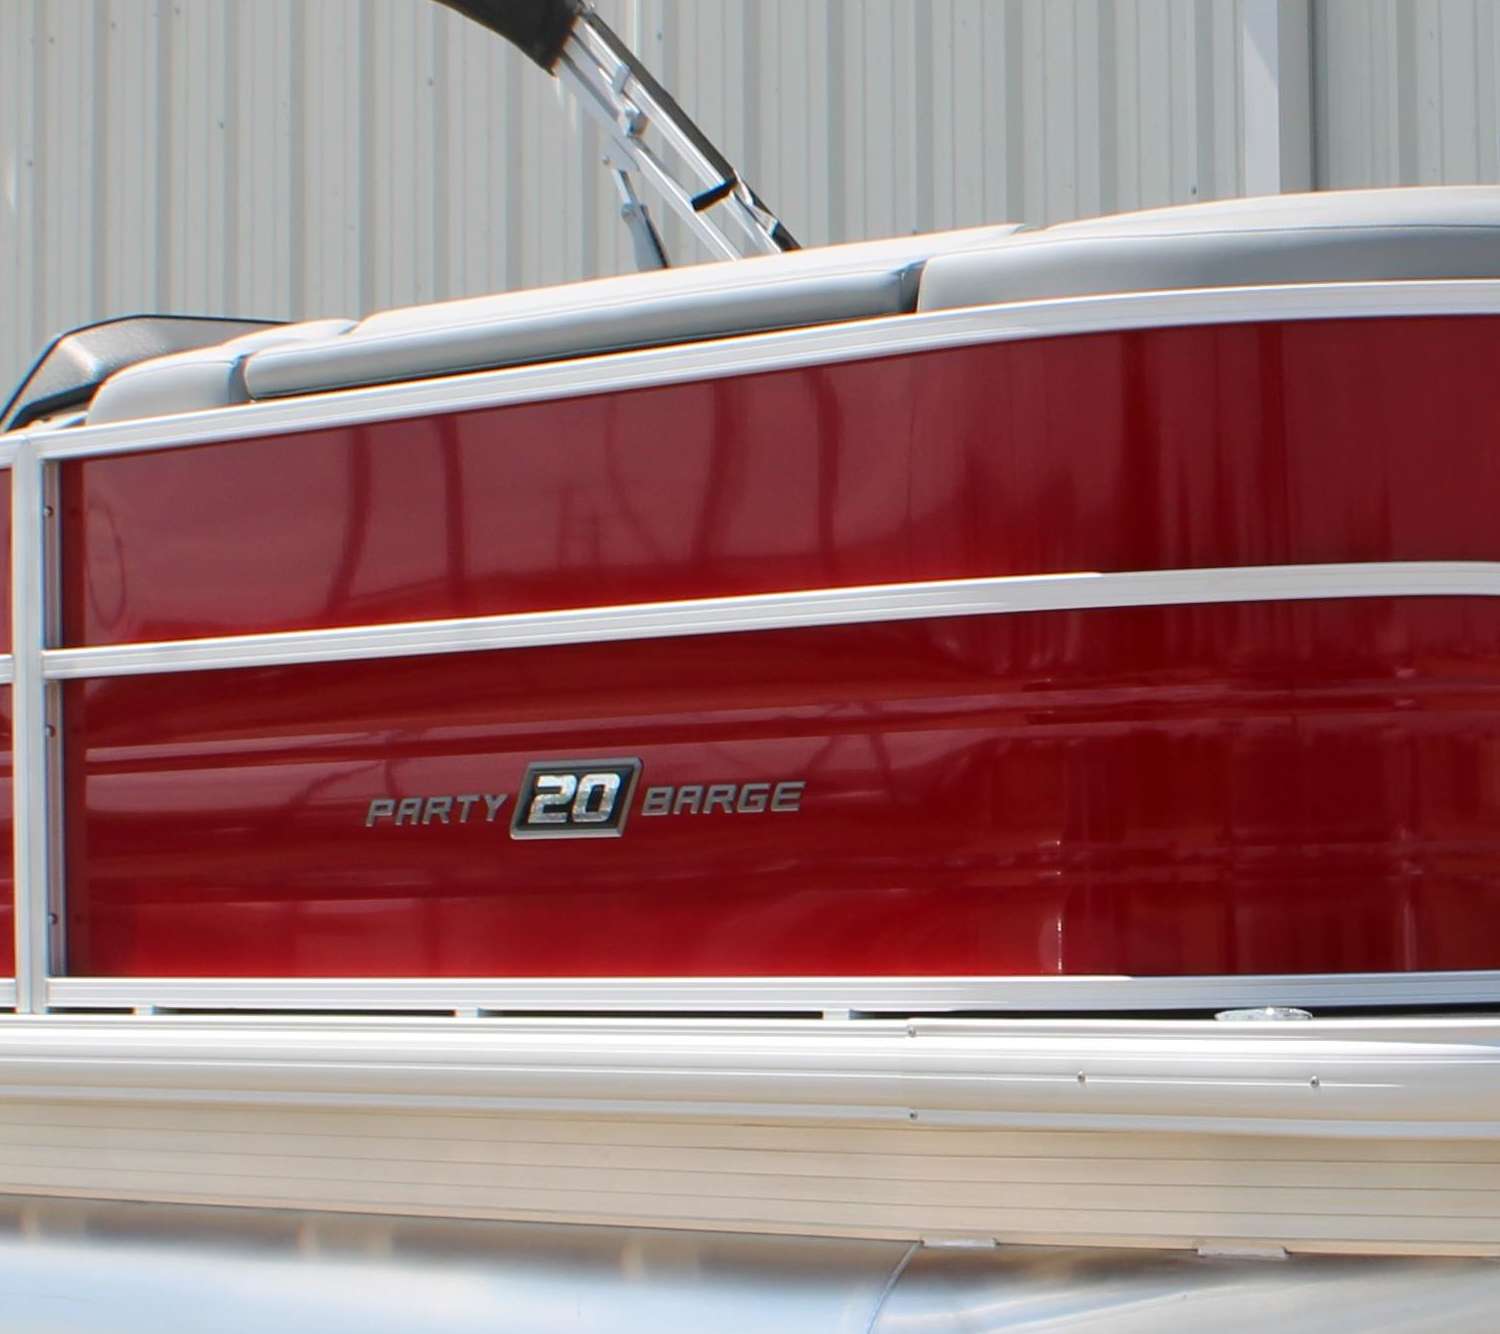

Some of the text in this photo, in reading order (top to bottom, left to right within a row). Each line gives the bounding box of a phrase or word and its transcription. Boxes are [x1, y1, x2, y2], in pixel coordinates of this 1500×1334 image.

[364, 771, 806, 827] PARTY 20 BARGE
